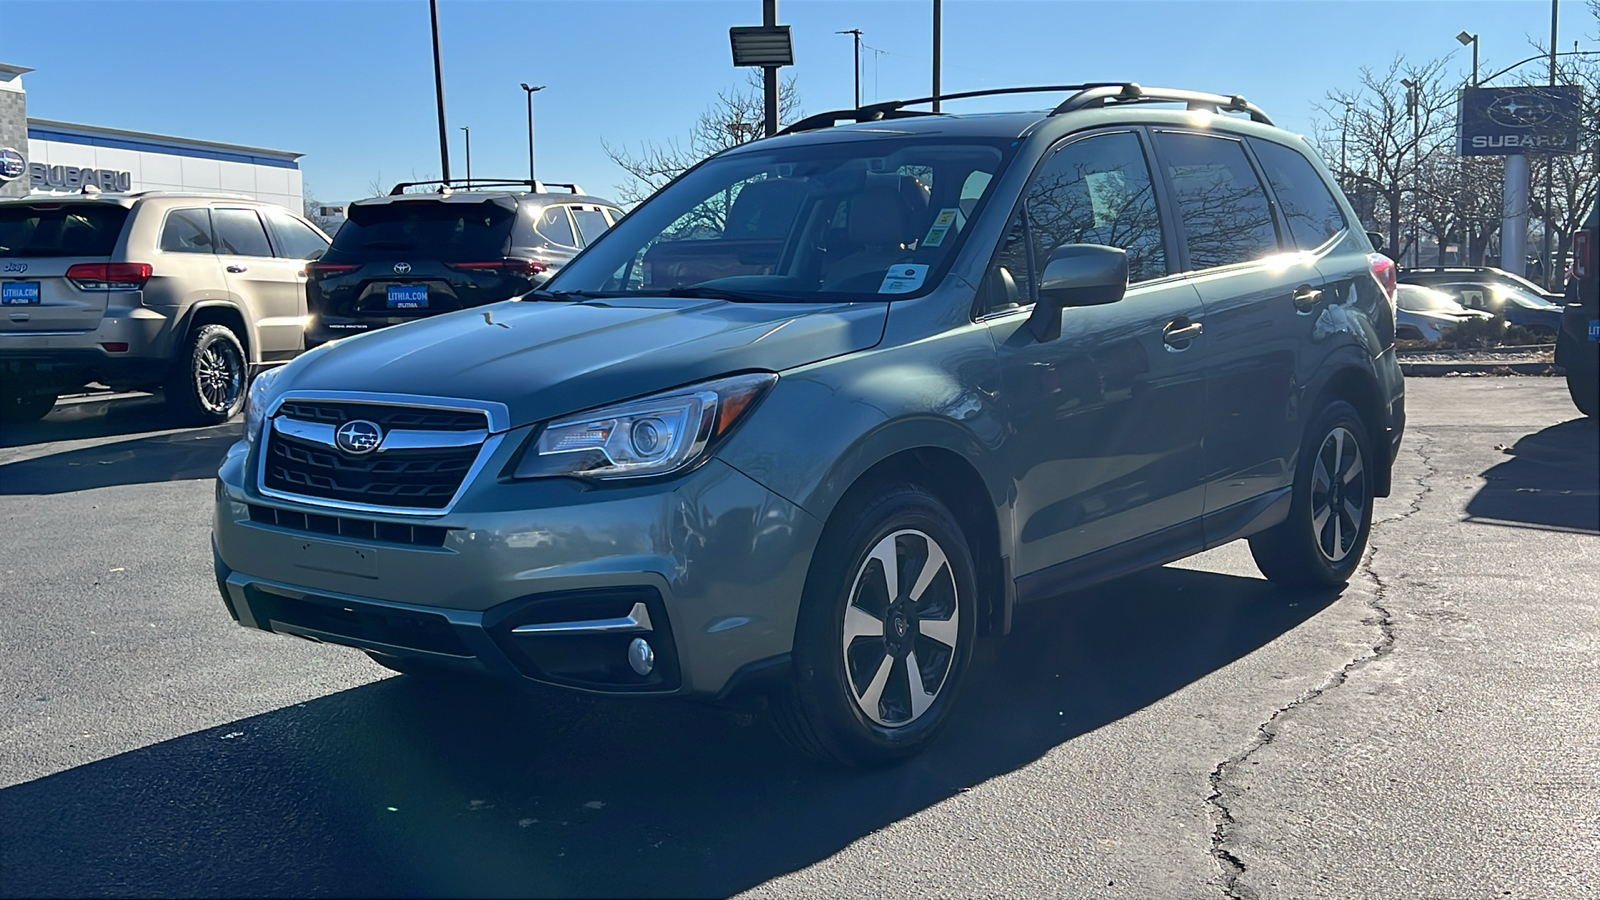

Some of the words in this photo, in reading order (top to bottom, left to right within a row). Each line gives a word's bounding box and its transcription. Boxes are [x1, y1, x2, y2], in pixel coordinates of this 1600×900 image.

[30, 162, 131, 192] SUBARU
[4, 262, 28, 274] Jeep
[3, 288, 38, 297] LITHIA.COM
[388, 292, 428, 301] LITHIA.COM
